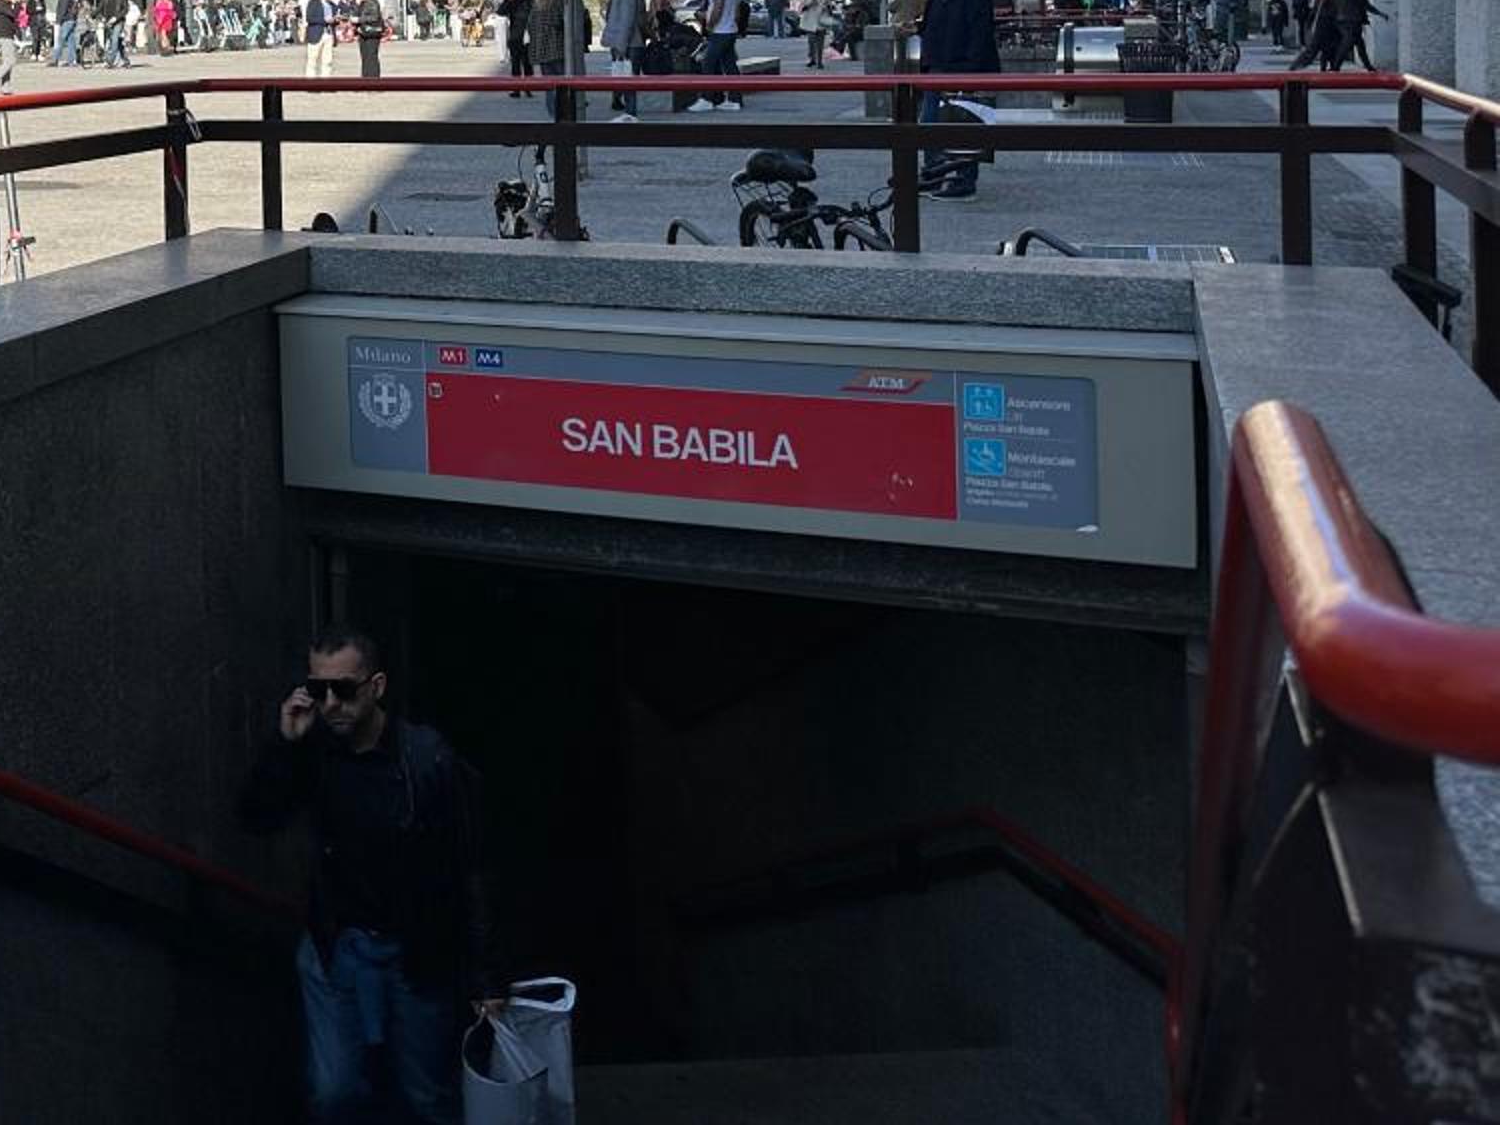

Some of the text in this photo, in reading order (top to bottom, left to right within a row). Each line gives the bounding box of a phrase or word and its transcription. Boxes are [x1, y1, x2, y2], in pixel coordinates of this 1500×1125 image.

[355, 347, 412, 364] Milano
[441, 350, 501, 365] M1 M4
[868, 377, 904, 389] ATM
[562, 417, 799, 470] SAN BABILA
